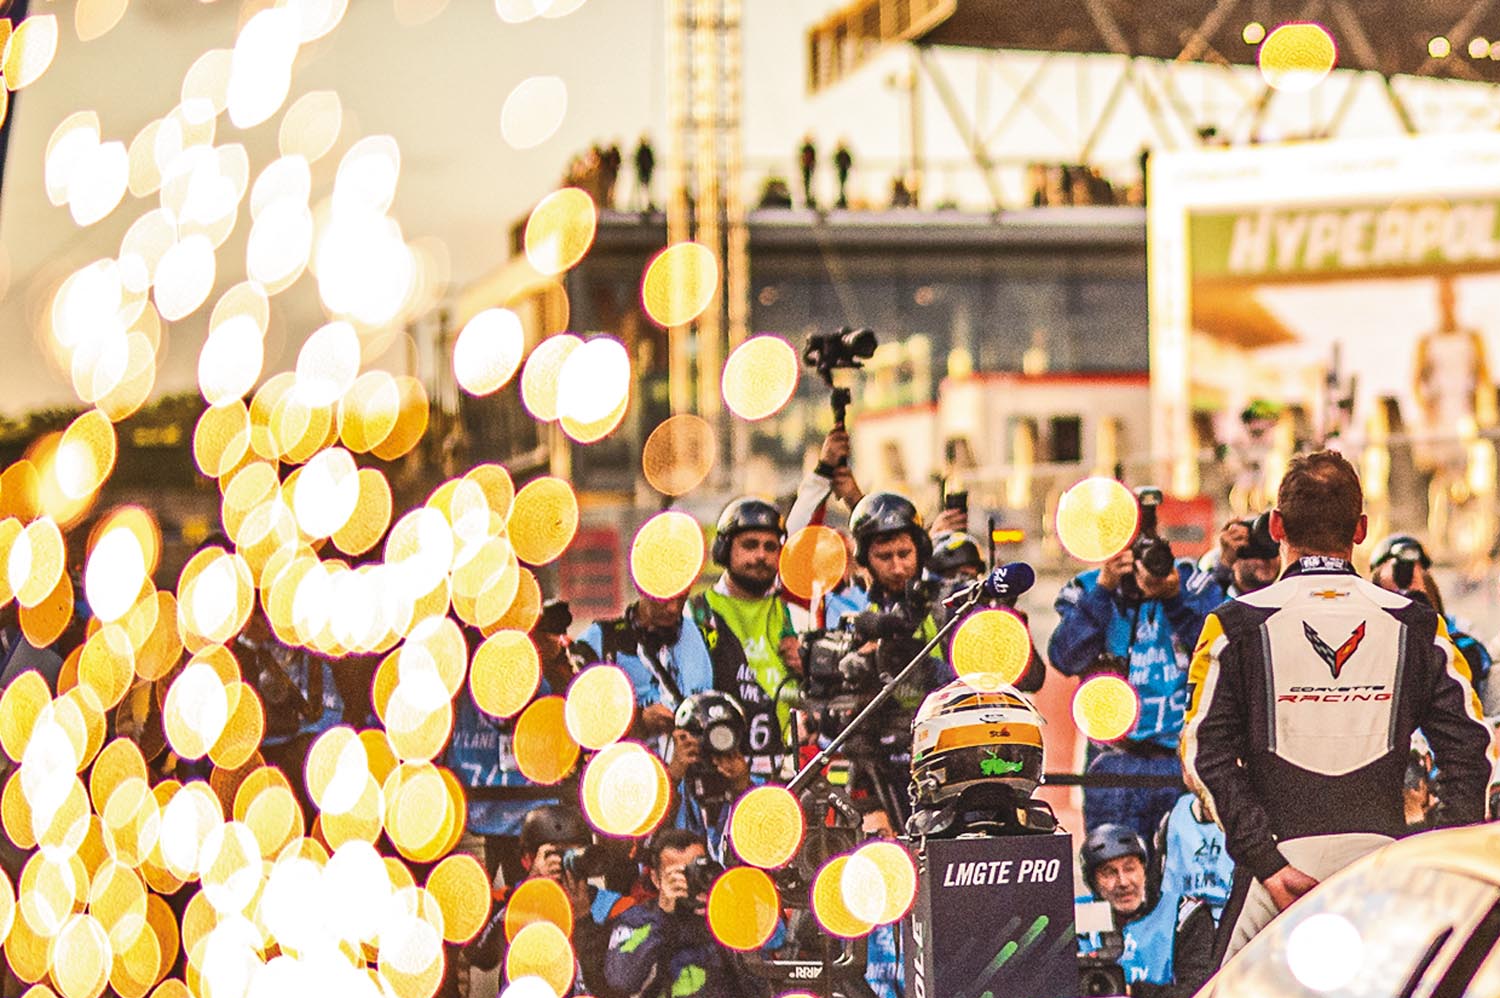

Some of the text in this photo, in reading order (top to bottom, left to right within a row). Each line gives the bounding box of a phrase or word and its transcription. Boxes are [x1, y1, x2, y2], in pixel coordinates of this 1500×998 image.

[1289, 685, 1386, 693] CORVETTE
[1278, 693, 1393, 703] RACING
[943, 859, 1061, 888] LMGTE PRO
